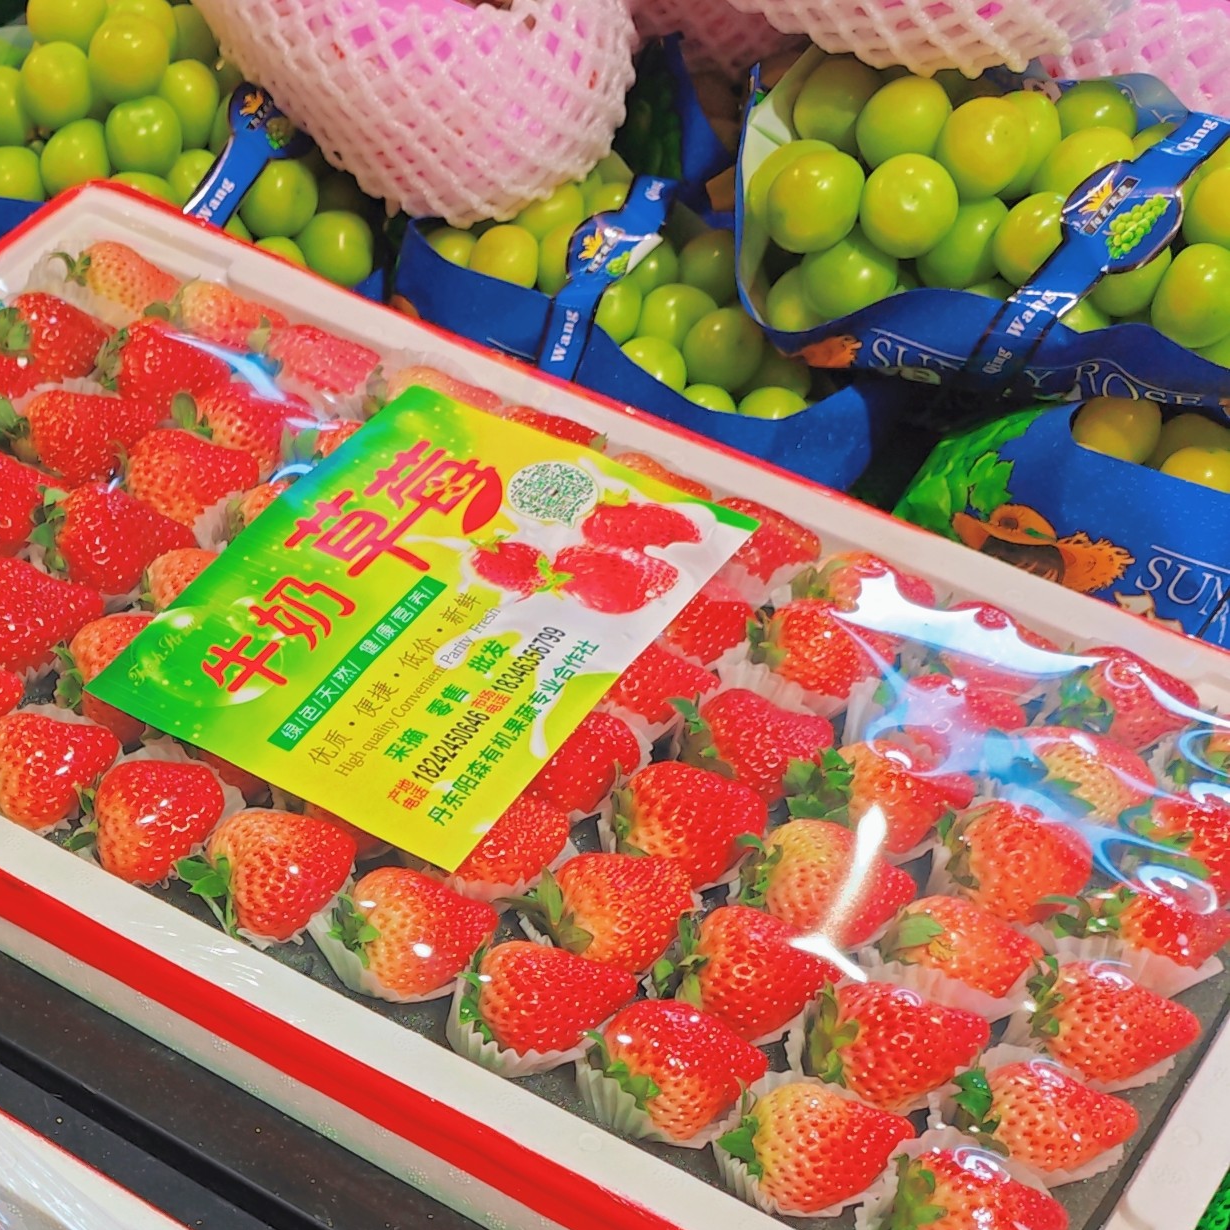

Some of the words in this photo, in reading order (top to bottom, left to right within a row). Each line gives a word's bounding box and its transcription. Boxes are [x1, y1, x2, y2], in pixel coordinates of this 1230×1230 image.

[1177, 119, 1219, 152] Qing
[550, 309, 580, 362] Wang
[202, 440, 503, 693] 牛奶草莓
[334, 750, 366, 777] High
[362, 717, 400, 752] quality
[391, 663, 448, 719] Convenient
[440, 634, 476, 666] Parity
[469, 606, 502, 635] Fresh
[384, 728, 429, 763] 采摘
[425, 683, 470, 717] 零售
[467, 639, 510, 675] 批发
[411, 709, 490, 785] 18242450646
[491, 626, 566, 694] 18346356799
[427, 639, 600, 827] 丹东阳森有机果蔬专业合作社
